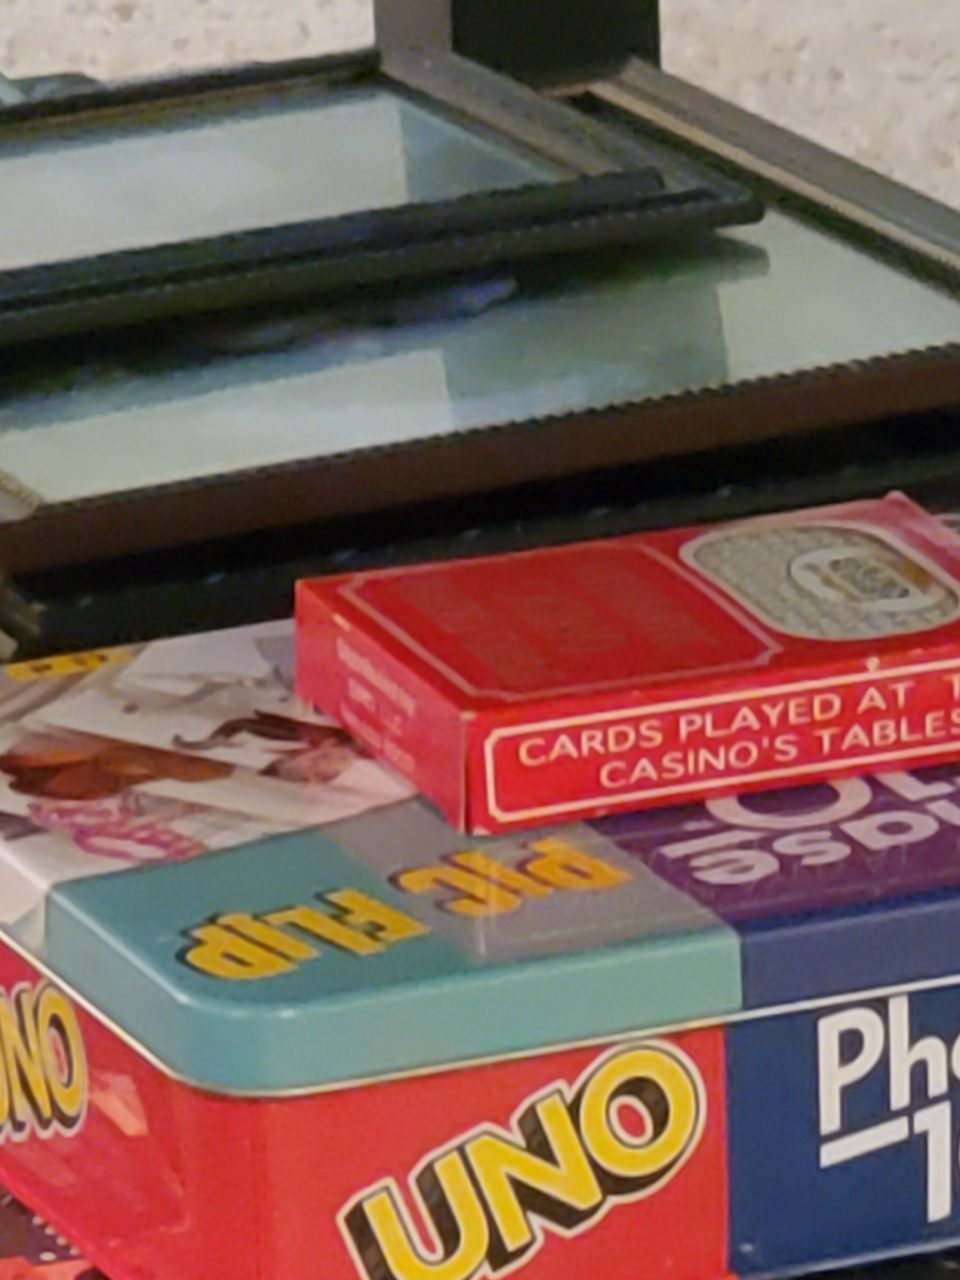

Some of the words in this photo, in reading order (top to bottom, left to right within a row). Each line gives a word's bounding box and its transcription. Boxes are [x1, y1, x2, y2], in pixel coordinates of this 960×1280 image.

[517, 719, 664, 768] CARDS
[678, 691, 843, 745] PLAYED
[857, 680, 913, 717] AT
[598, 732, 799, 790] CASINO'S
[0, 979, 89, 1143] NO
